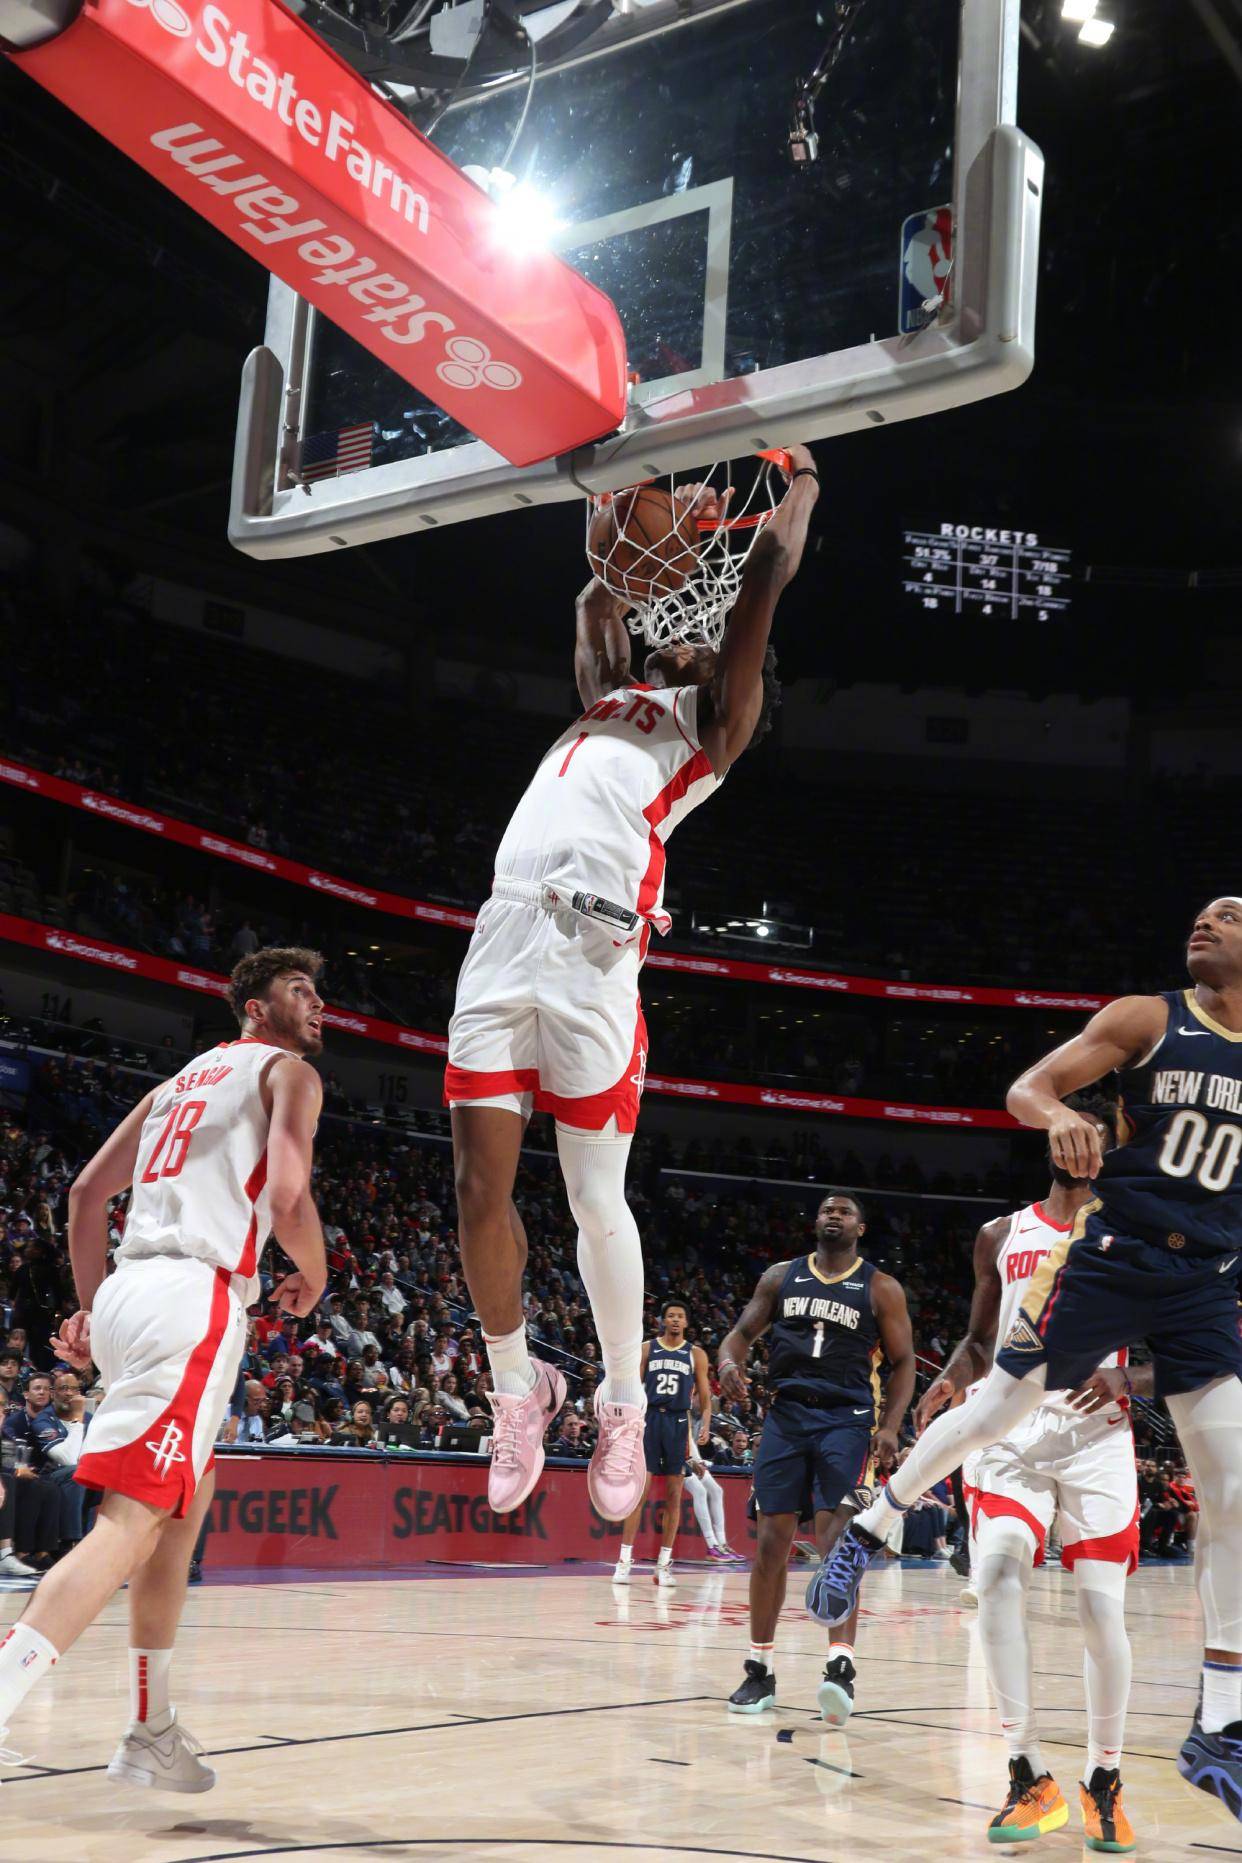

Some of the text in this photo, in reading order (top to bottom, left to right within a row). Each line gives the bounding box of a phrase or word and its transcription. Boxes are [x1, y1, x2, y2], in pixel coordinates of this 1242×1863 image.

[941, 523, 1038, 547] ROCKETS
[1151, 1070, 1205, 1105] NEW
[1158, 1109, 1242, 1192] 00
[1006, 1250, 1050, 1284] ROC
[783, 1296, 861, 1330] NEW ORLEANS
[812, 1321, 825, 1358] 1
[656, 1373, 679, 1396] 25
